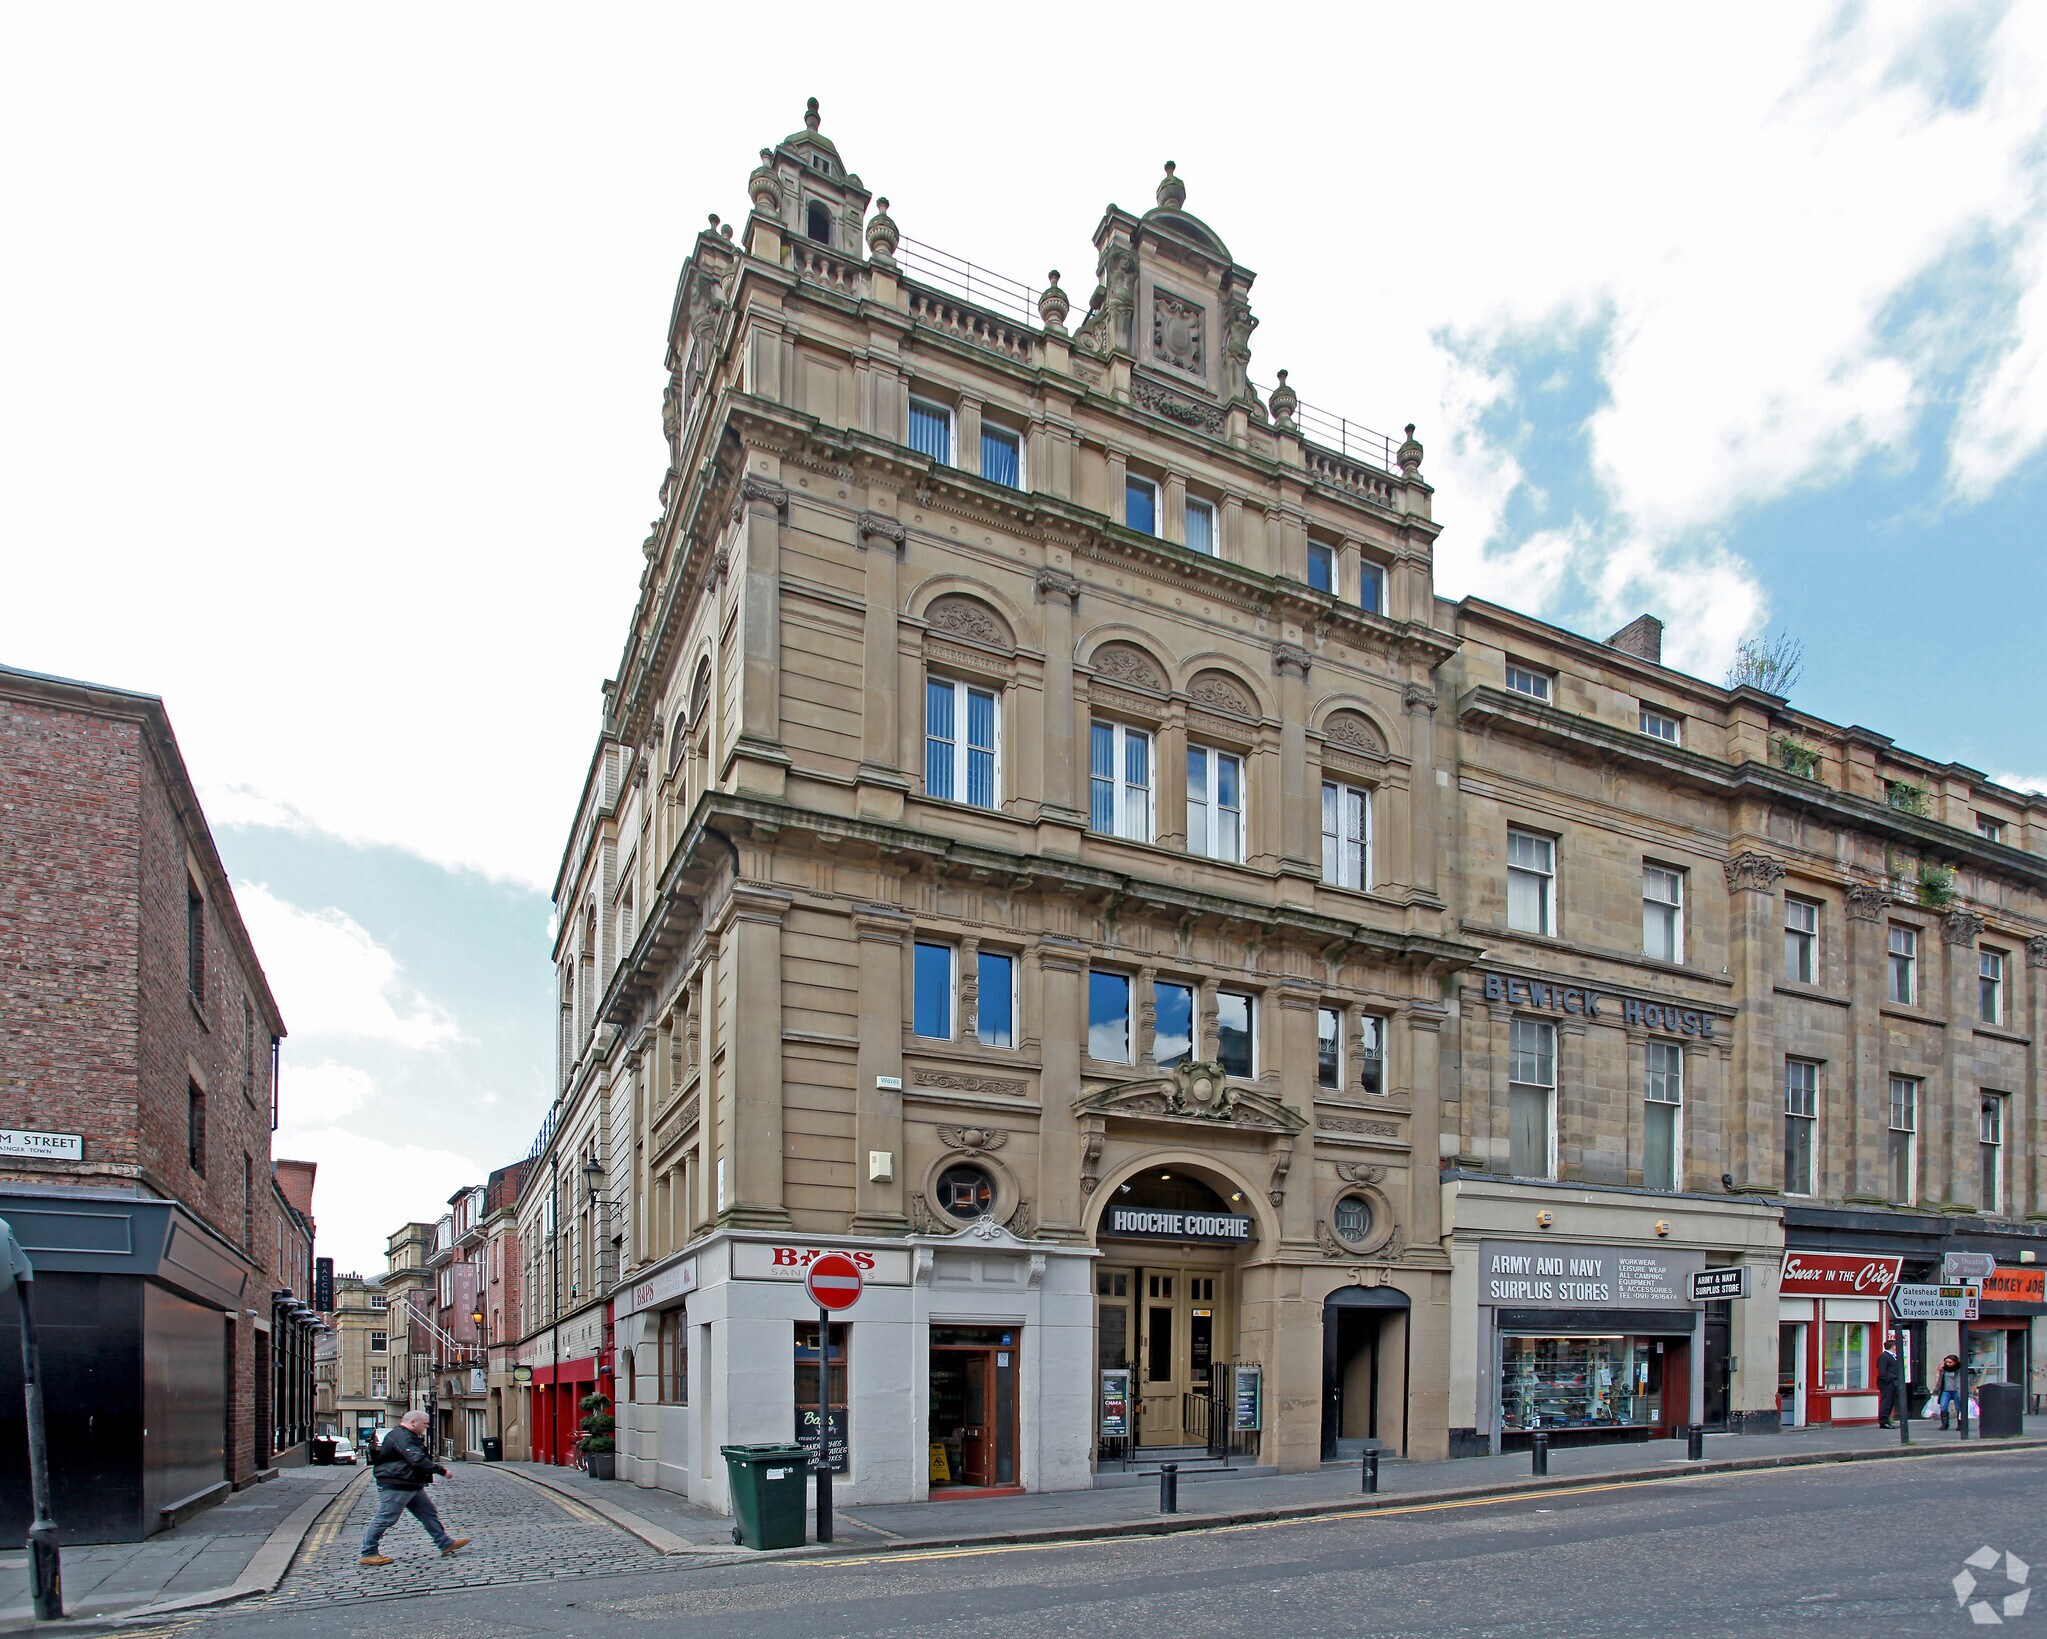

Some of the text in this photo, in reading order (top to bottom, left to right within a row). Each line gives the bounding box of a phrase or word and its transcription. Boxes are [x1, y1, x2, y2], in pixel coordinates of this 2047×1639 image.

[1484, 972, 1716, 1038] BEWICK HOUSE
[24, 1136, 77, 1148] STREET
[1114, 1211, 1249, 1238] HOOCHIE COOCHIE
[771, 1247, 876, 1270] BAS
[1619, 1258, 1656, 1266] WORKWEAR
[1961, 1257, 1985, 1266] Theatre
[1491, 1255, 1602, 1277] ARMY AND NAVY
[1619, 1265, 1646, 1273] LEISURE
[1963, 1266, 1981, 1274] Royal
[771, 1268, 875, 1280] SANES
[1697, 1273, 1737, 1285] ARMY & NAVY
[1784, 1258, 1894, 1293] Snax IN THE City
[1490, 1280, 1609, 1301] SURPLUS STORES
[1627, 1286, 1673, 1294] ACCESSORIES
[1695, 1284, 1740, 1296] SURPLUS STORE
[1902, 1287, 1938, 1296] Gateshead
[1982, 1277, 2043, 1294] SMOKEY JOE
[637, 1282, 654, 1306] BAPS
[1902, 1299, 1916, 1307] City
[1903, 1308, 1930, 1317] Blaydon
